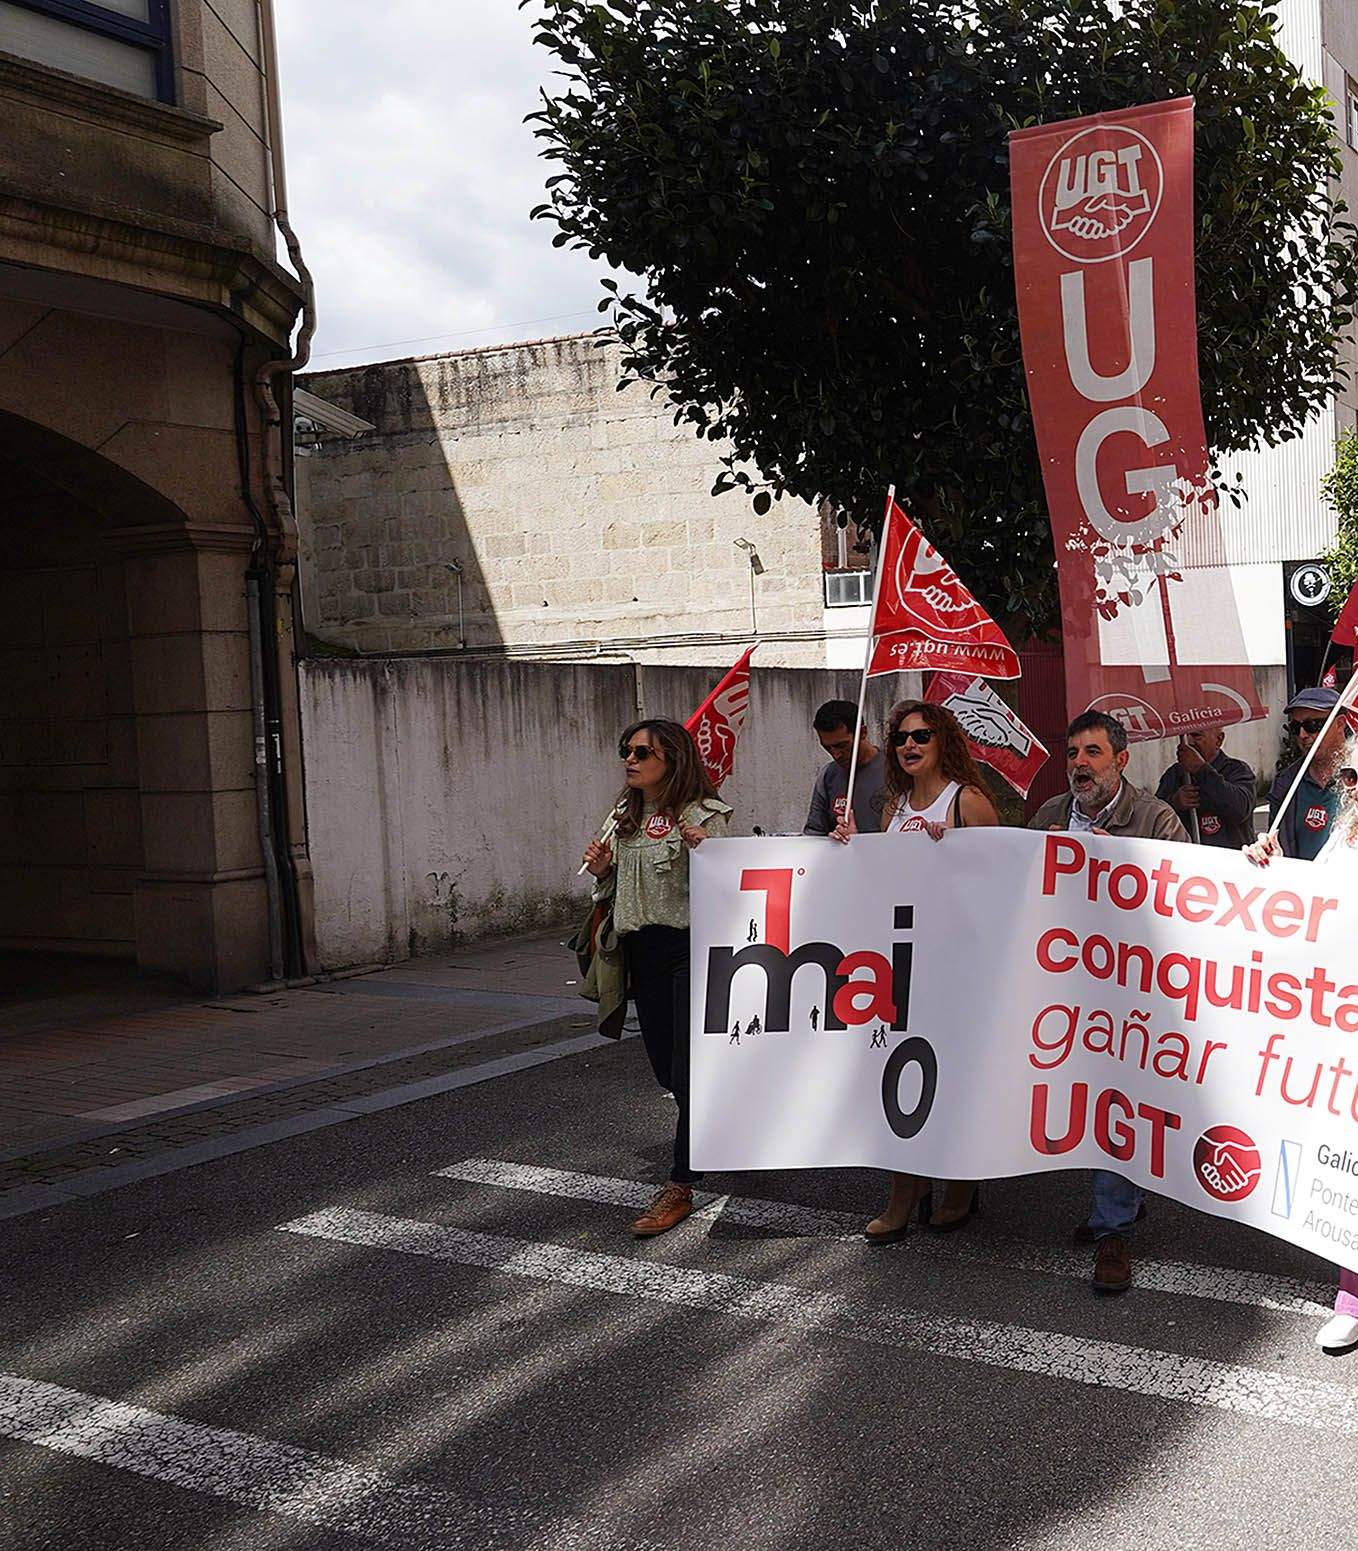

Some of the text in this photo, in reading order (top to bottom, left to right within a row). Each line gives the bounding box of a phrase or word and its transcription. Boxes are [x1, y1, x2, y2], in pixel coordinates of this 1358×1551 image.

[1055, 145, 1143, 207] UGT
[889, 640, 1005, 661] www.ugt.es
[1169, 706, 1222, 724] Galicia
[1041, 834, 1338, 942] Protexer
[1027, 1004, 1228, 1084] gañar
[1030, 1082, 1181, 1178] UGT
